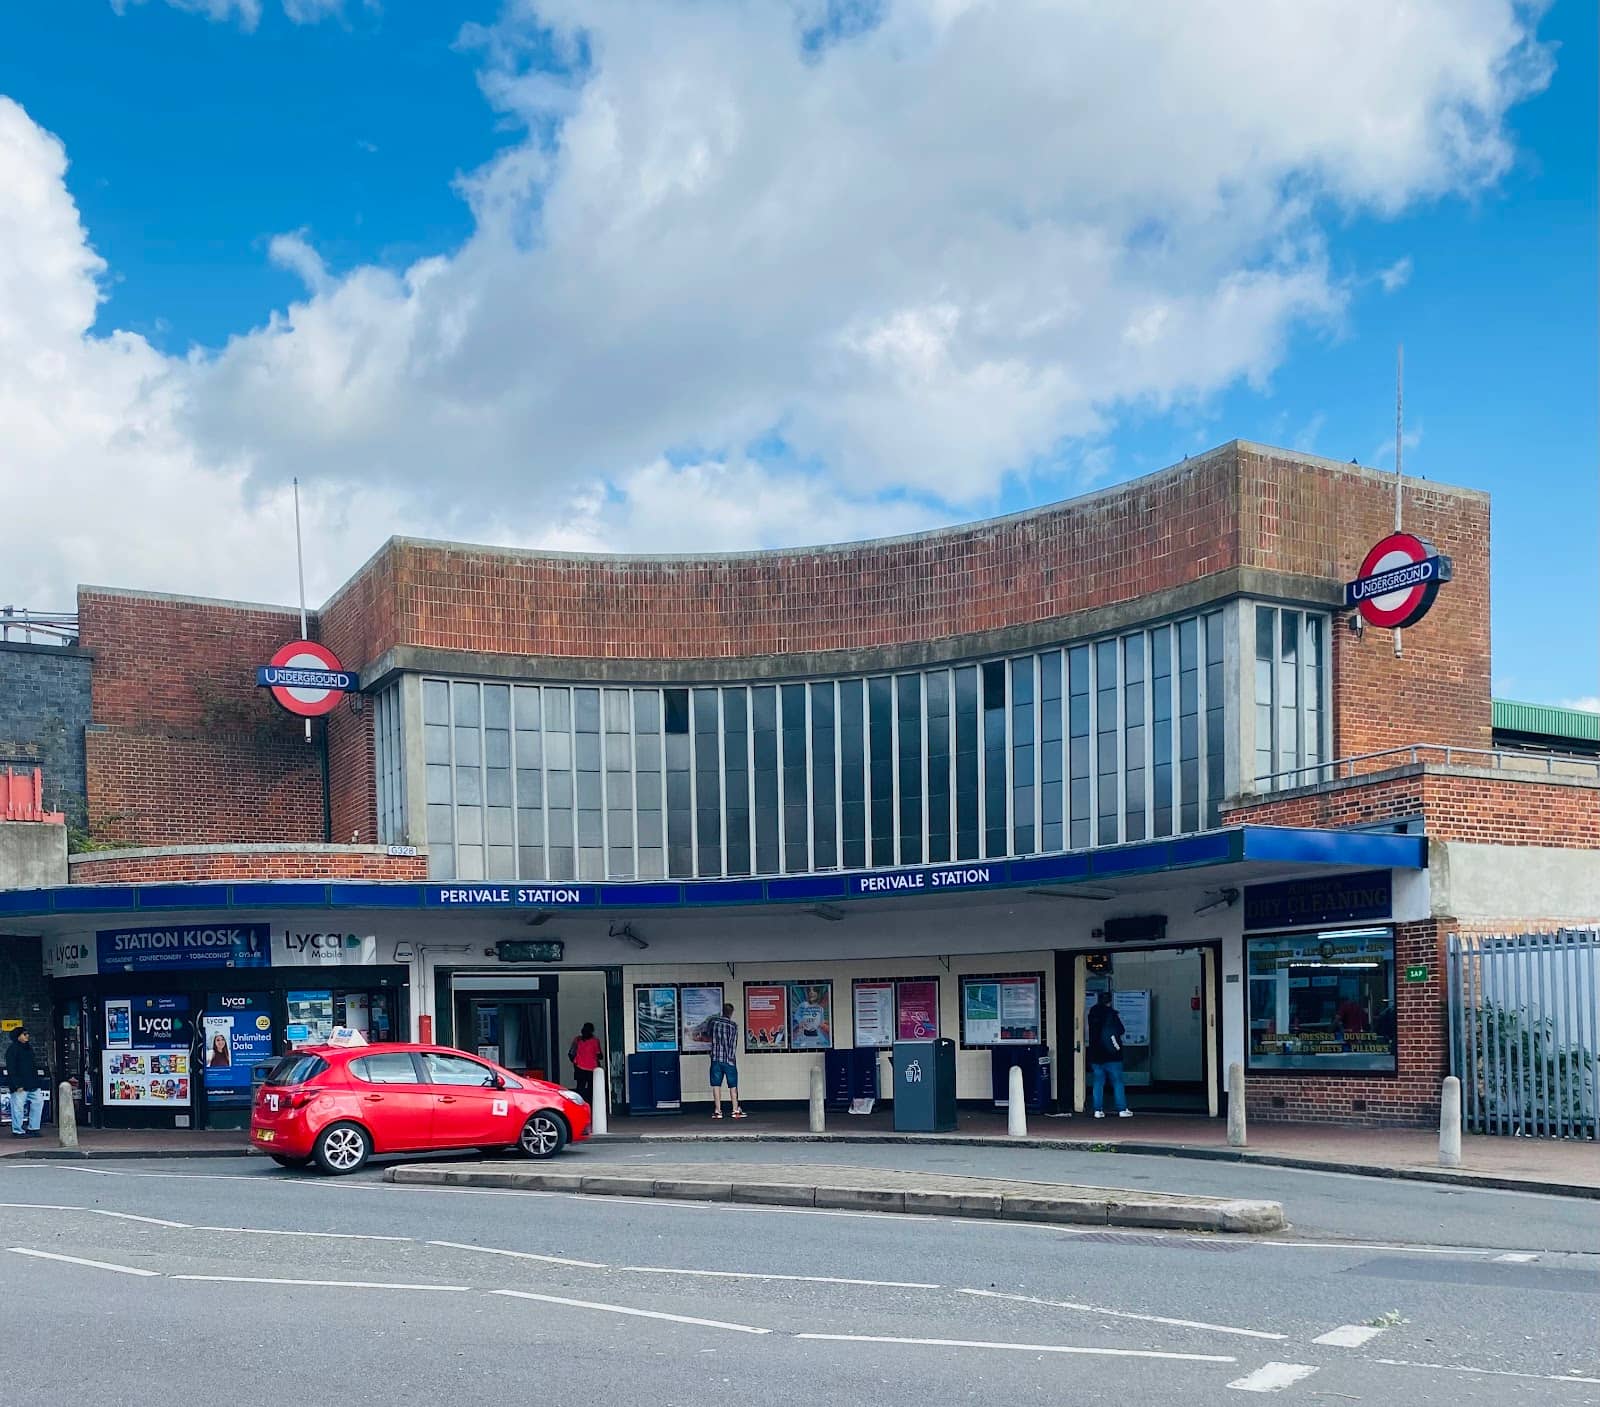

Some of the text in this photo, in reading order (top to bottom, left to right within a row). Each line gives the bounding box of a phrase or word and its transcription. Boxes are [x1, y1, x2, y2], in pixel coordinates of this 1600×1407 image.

[1353, 563, 1432, 599] UNDERGROUND
[265, 669, 349, 687] UNDERGROUND
[391, 847, 414, 855] G328
[861, 869, 990, 891] PERIVALE STATION
[440, 889, 579, 902] PERIVALE STATION
[1288, 888, 1387, 913] CLEANING
[115, 929, 241, 950] STATION KIOSK
[285, 930, 342, 952] Lyca
[56, 944, 78, 964] Lyca
[311, 950, 343, 958] Mobile
[221, 996, 245, 1007] Lyca
[138, 1015, 171, 1033] Lyca
[232, 1032, 271, 1042] Unlimited
[232, 1042, 253, 1050] Data
